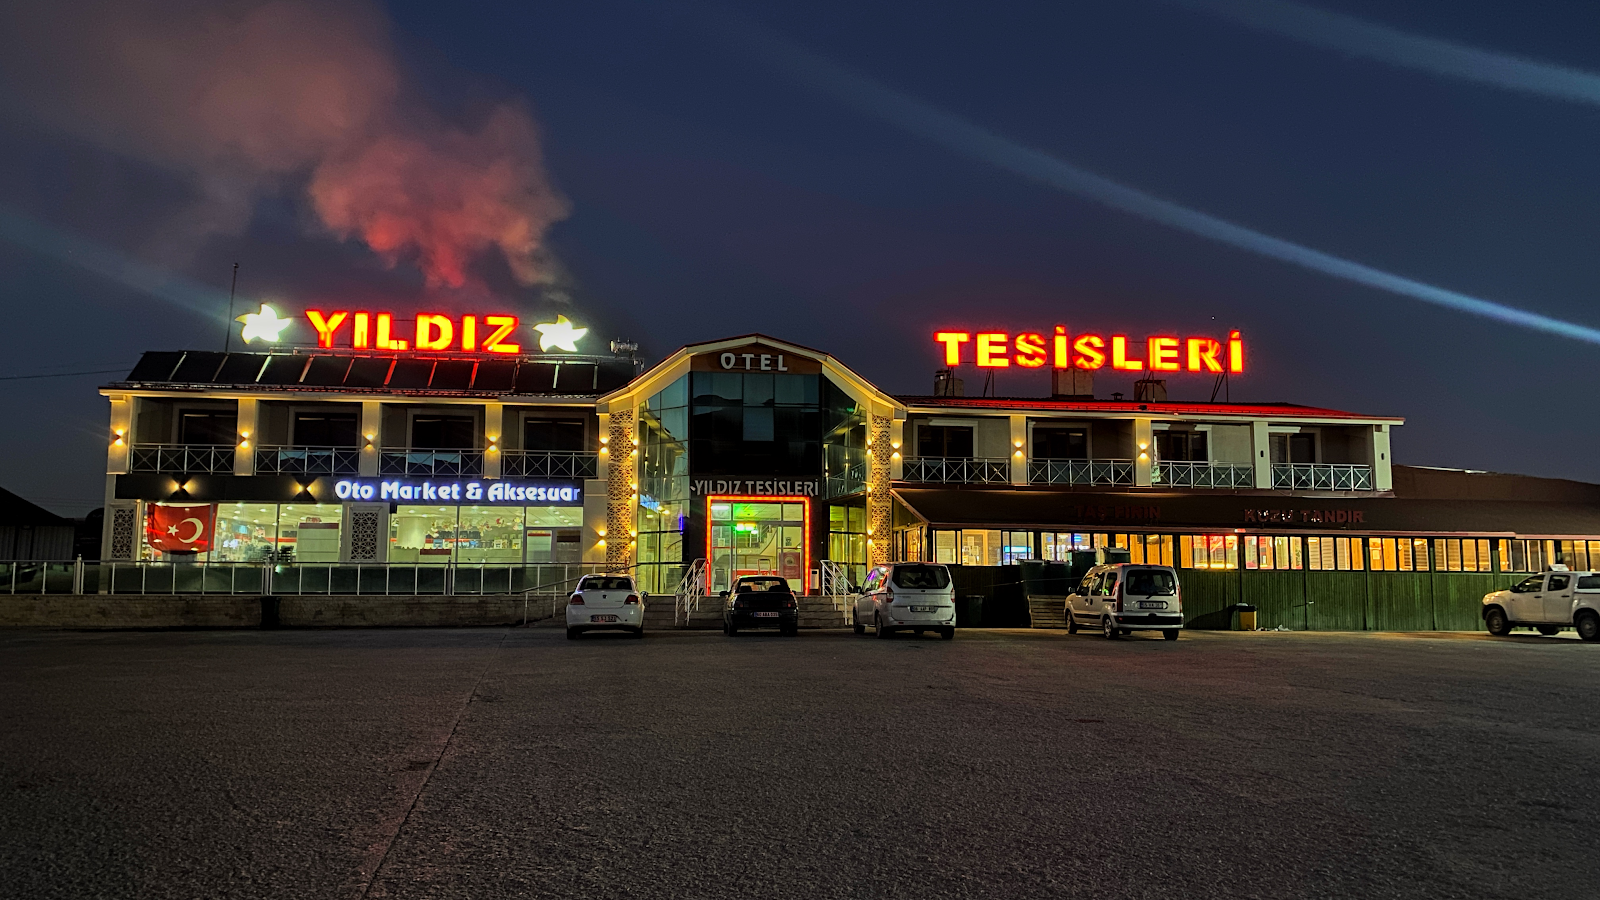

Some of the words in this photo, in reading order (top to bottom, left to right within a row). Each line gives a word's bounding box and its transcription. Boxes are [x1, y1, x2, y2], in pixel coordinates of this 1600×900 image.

[304, 308, 521, 354] YILDIZ
[933, 324, 1244, 373] TESİSLERİ
[720, 352, 788, 372] OTEL
[334, 480, 374, 500] Oto
[380, 481, 460, 501] Market
[465, 482, 483, 501] &
[487, 482, 581, 502] Aksesuar
[694, 479, 742, 496] YILDIZ
[745, 478, 819, 497] TESİSLERİ
[1298, 509, 1365, 523] TANDIR
